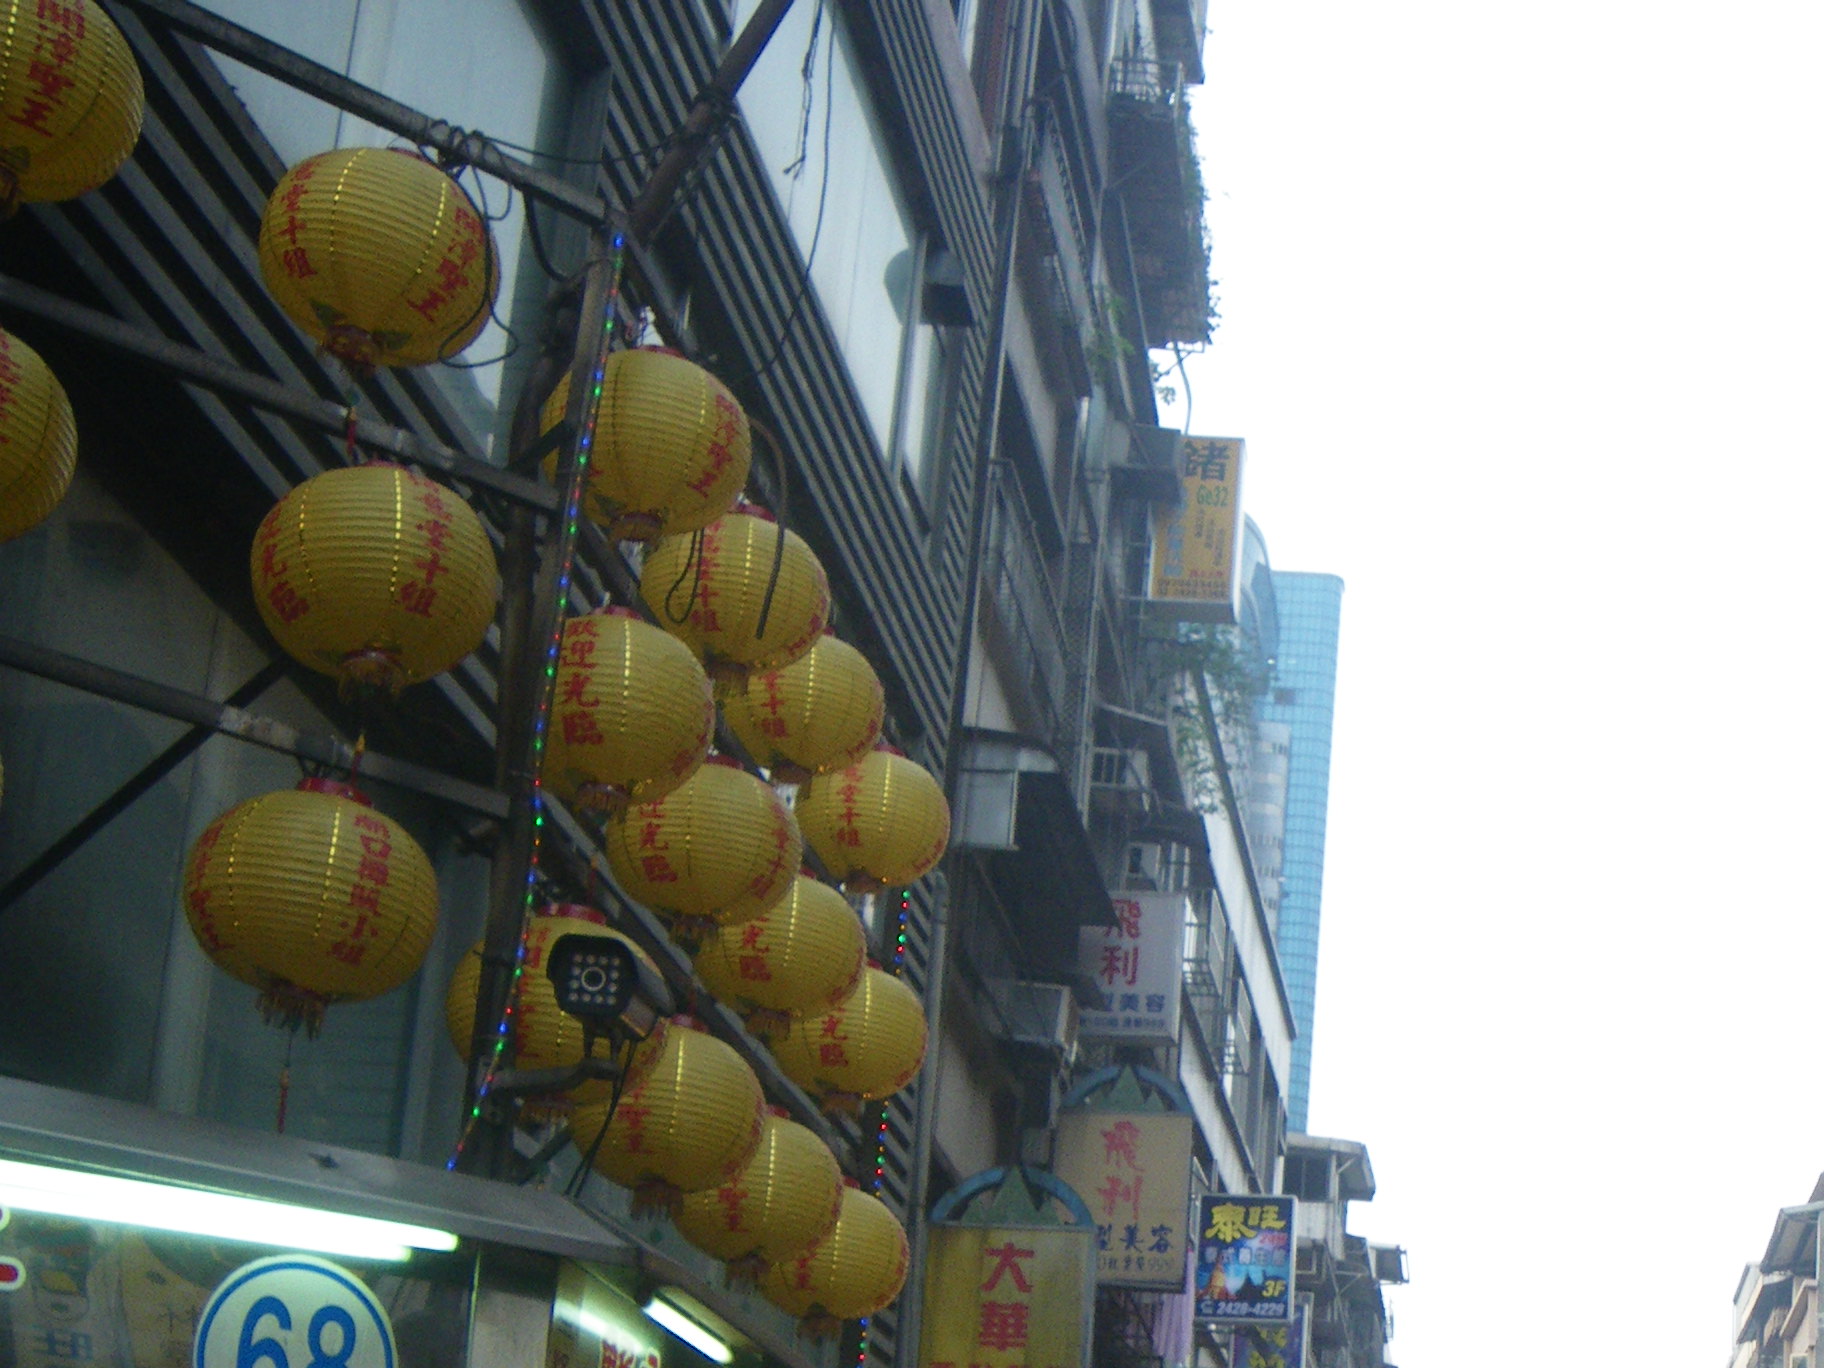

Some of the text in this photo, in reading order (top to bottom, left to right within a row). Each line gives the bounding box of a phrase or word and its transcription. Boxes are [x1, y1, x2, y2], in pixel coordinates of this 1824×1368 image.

[1205, 1205, 1286, 1244] 泰旺
[978, 1242, 1035, 1352] 大華
[1262, 1280, 1286, 1298] 3F
